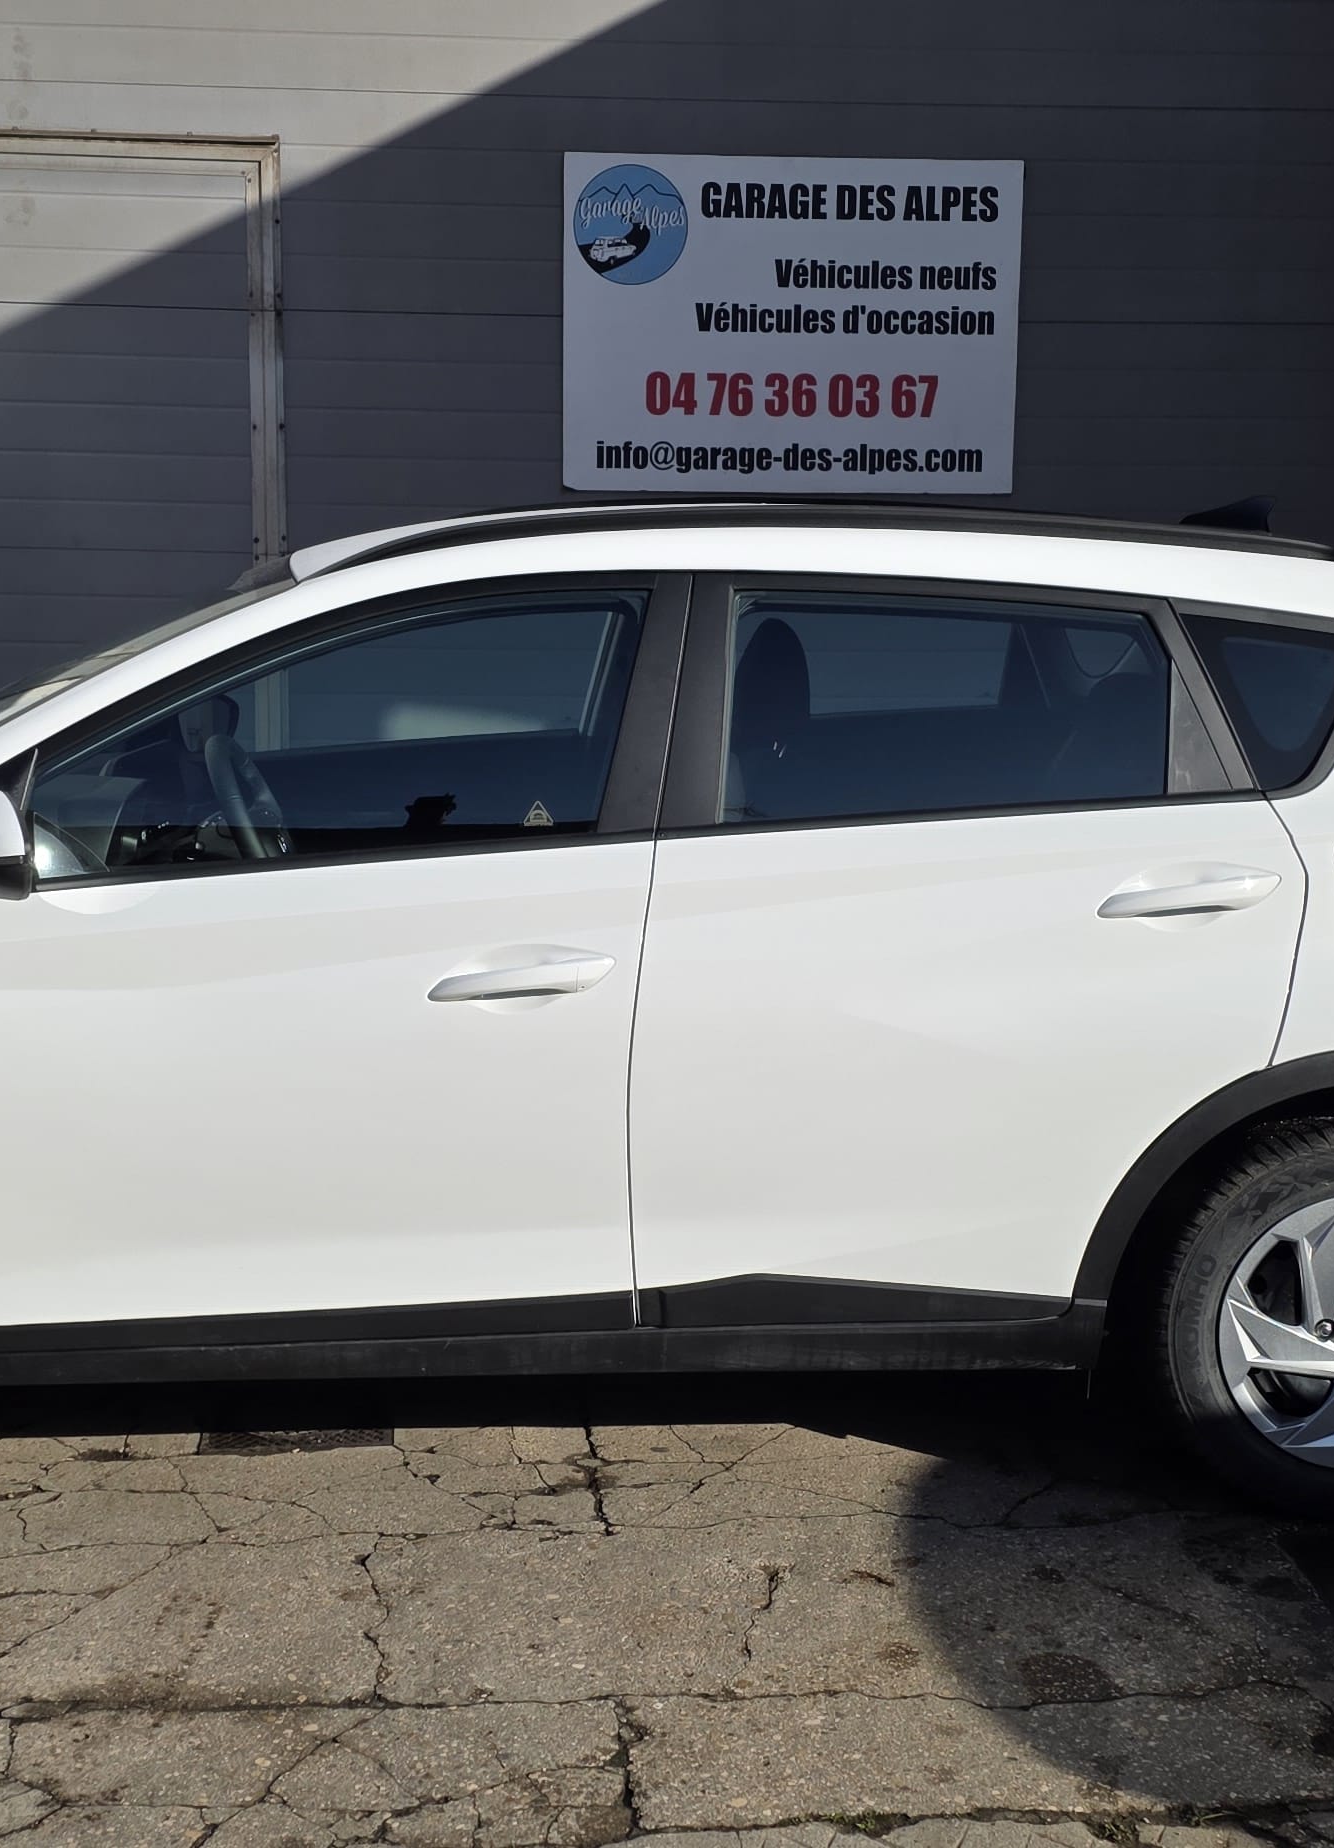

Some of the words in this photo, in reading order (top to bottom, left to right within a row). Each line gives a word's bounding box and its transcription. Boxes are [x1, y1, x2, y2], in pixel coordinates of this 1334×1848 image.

[579, 196, 642, 230] Garage
[700, 181, 828, 220] GARAGE
[835, 183, 896, 222] DES
[902, 185, 1000, 223] ALPES
[639, 205, 685, 237] Alpes
[774, 258, 913, 291] Véhicules
[918, 260, 998, 292] neufs
[695, 302, 836, 334] Véhicules
[842, 304, 996, 336] d'occasion
[645, 371, 698, 416] 04
[706, 372, 754, 418] 76
[764, 372, 818, 418] 36
[827, 373, 880, 419] 03
[890, 374, 939, 419] 67
[595, 440, 984, 475] info@garage-des-alpes.com
